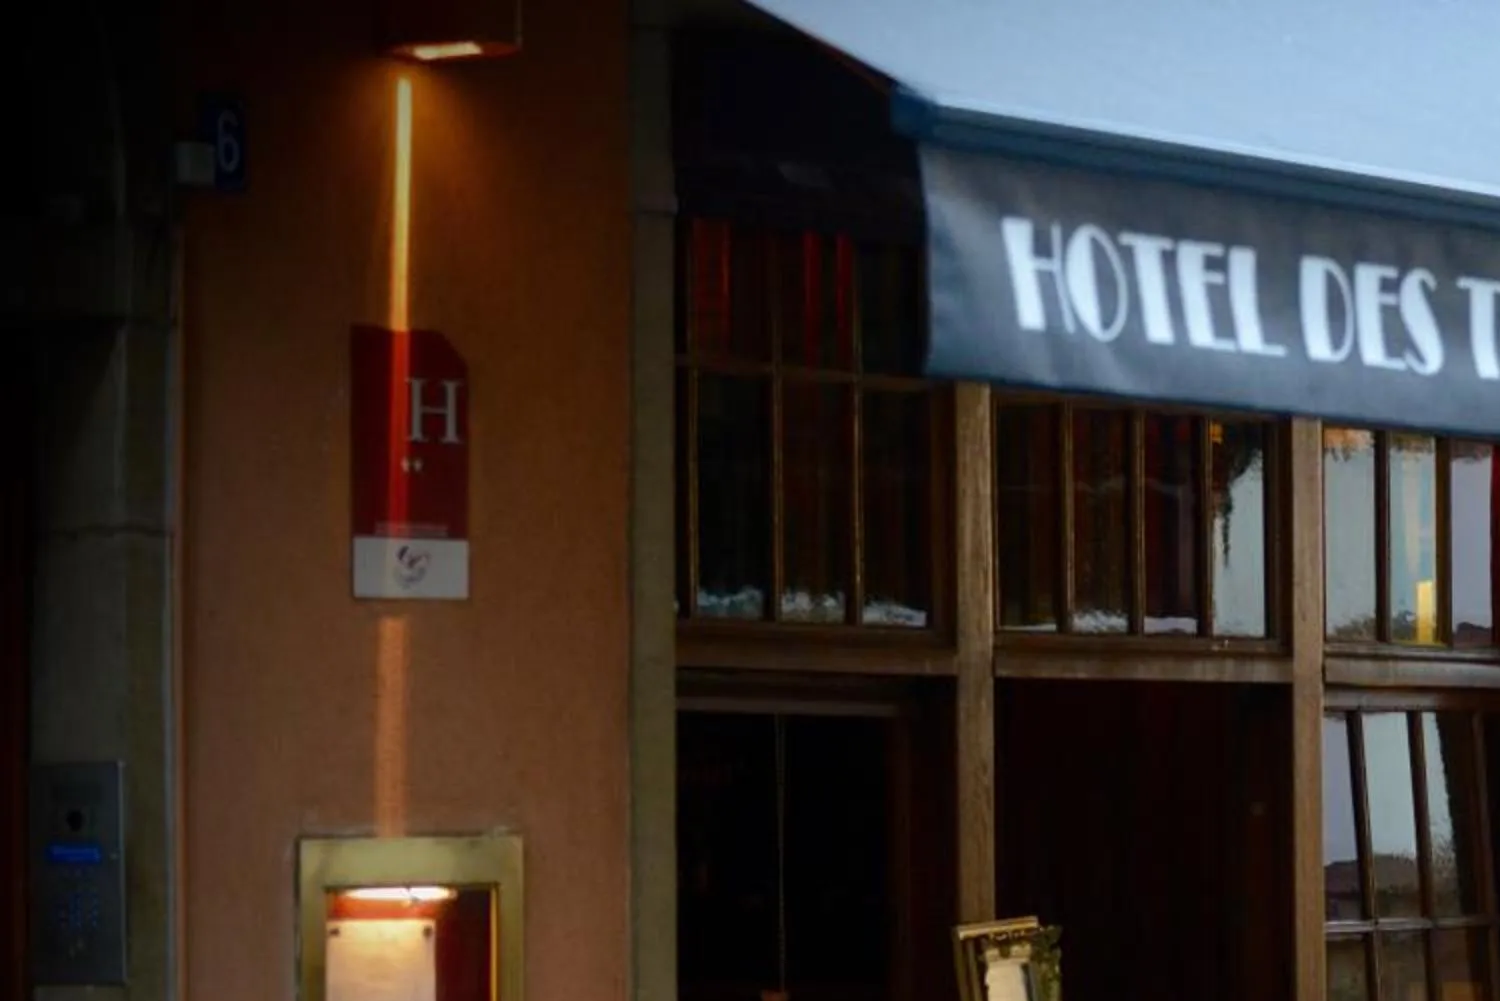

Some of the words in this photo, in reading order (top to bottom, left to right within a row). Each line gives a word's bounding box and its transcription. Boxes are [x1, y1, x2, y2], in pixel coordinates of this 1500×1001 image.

[1000, 216, 1285, 358] HOTEL
[1299, 255, 1444, 377] DES
[406, 377, 464, 445] H
